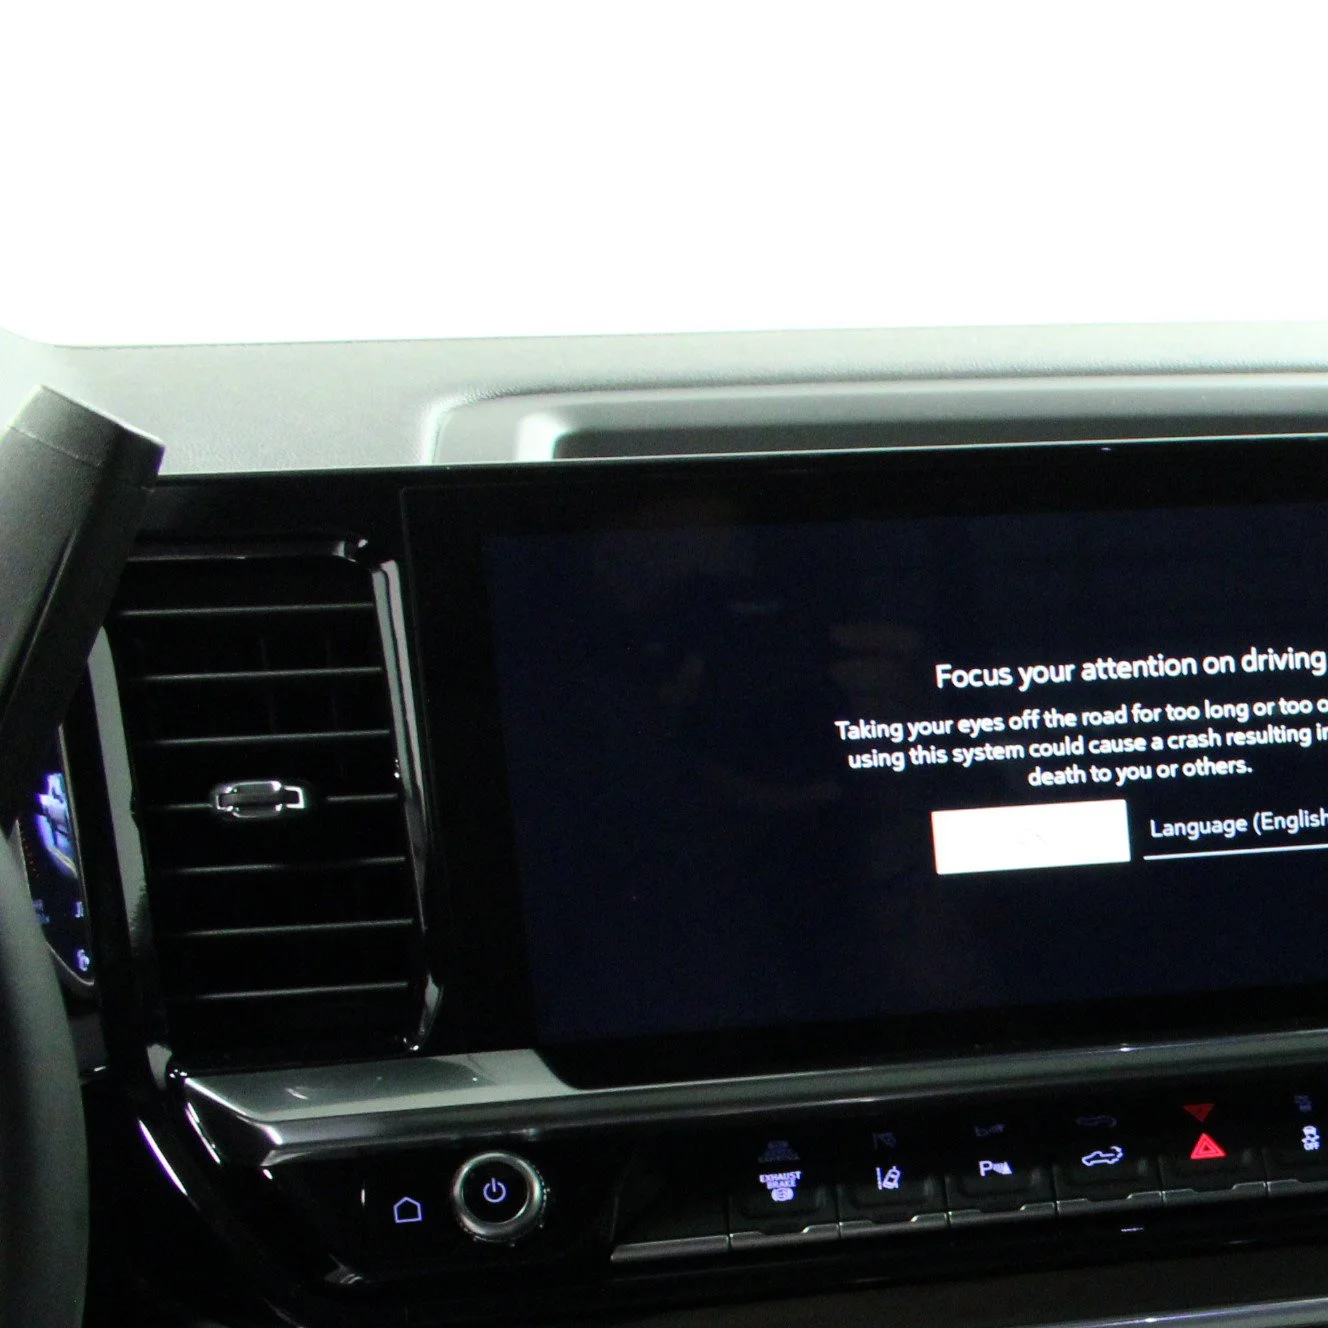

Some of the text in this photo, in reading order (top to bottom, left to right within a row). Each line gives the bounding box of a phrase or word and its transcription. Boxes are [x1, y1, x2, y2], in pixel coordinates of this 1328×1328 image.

[935, 646, 1328, 693] Focus your attention on driving
[834, 718, 904, 744] Taking
[906, 719, 954, 743] your
[957, 716, 1006, 739] eyes
[1008, 708, 1040, 731] off
[1043, 707, 1078, 729] the
[1081, 703, 1129, 727] road
[1130, 702, 1163, 724] for
[1164, 703, 1201, 722] too
[1204, 698, 1250, 724] long
[1252, 701, 1276, 717] or
[1277, 697, 1314, 716] too
[848, 748, 906, 773] using
[907, 744, 949, 766] this
[951, 742, 1025, 768] system
[1028, 734, 1085, 758] could
[1087, 736, 1148, 755] cause
[1150, 735, 1165, 751] a
[1167, 727, 1222, 750] crash
[1225, 723, 1313, 748] resulting
[1027, 755, 1253, 787] death to you or others.
[1149, 818, 1248, 841] Language
[759, 1170, 802, 1183] EXHAUST
